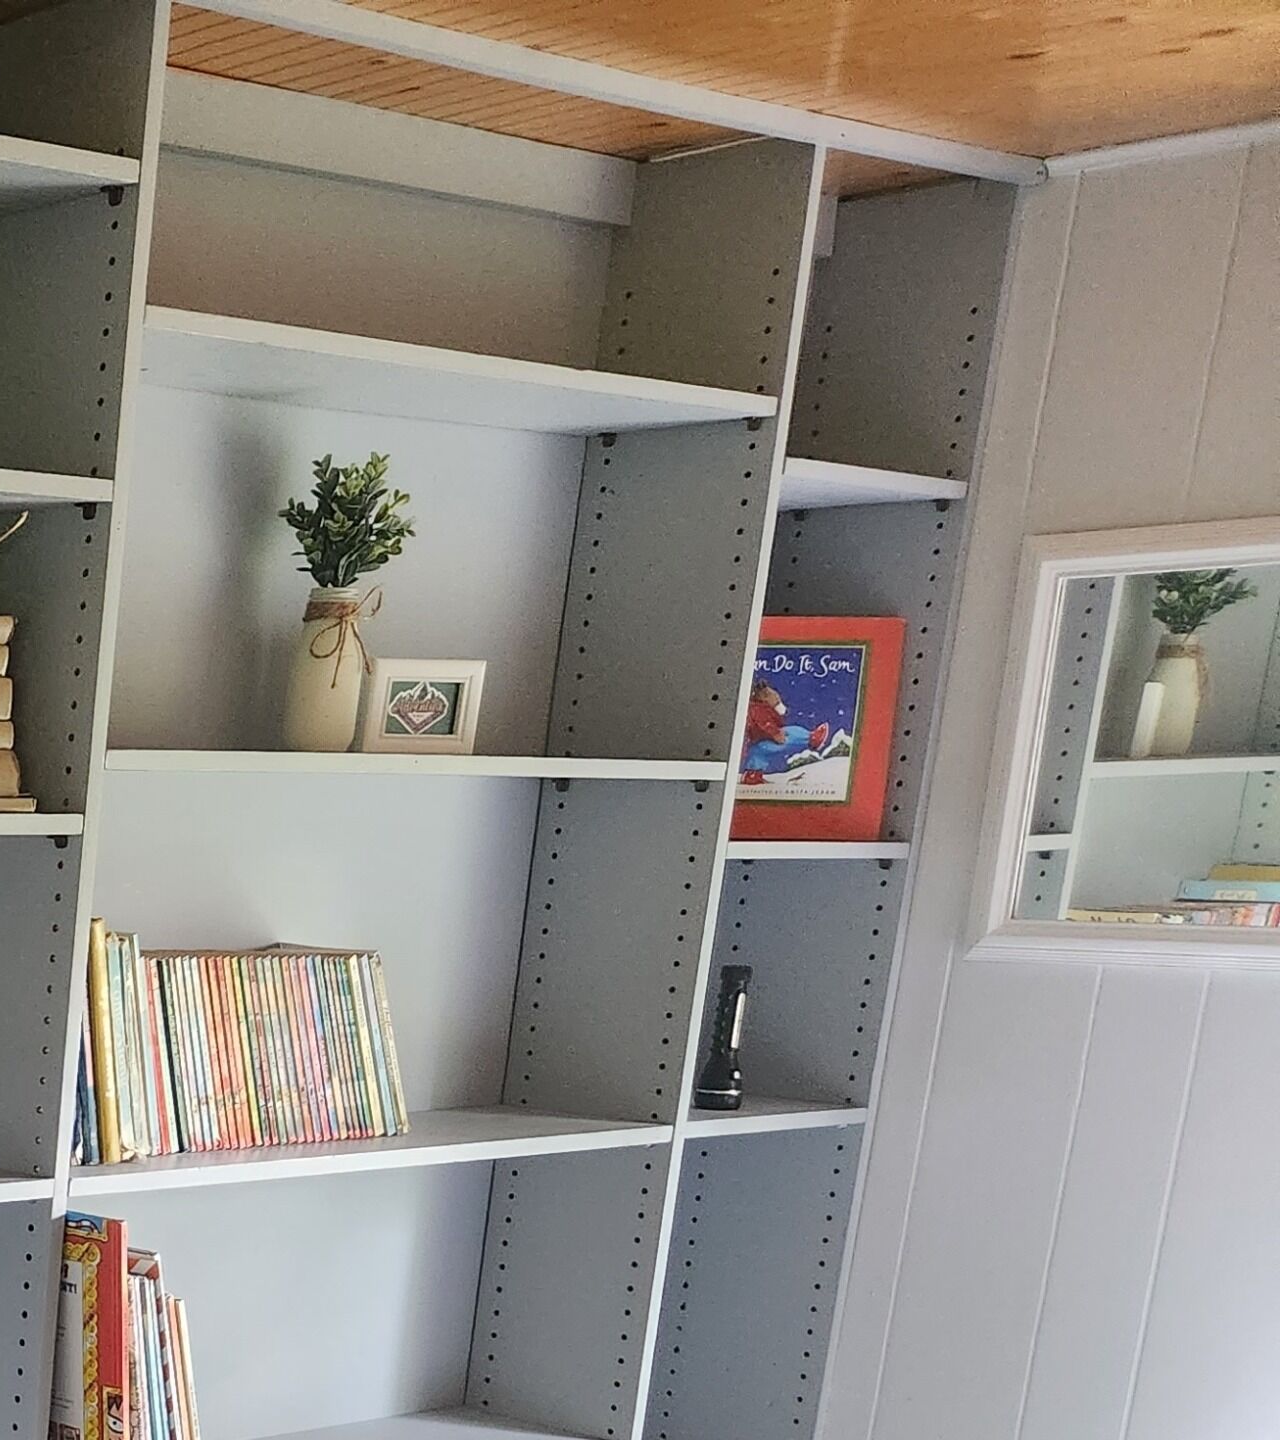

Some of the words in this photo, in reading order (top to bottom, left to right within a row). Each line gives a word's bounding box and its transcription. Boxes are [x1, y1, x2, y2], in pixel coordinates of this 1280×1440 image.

[772, 655, 794, 672] Do
[797, 654, 814, 675] It,
[814, 654, 855, 678] Sam
